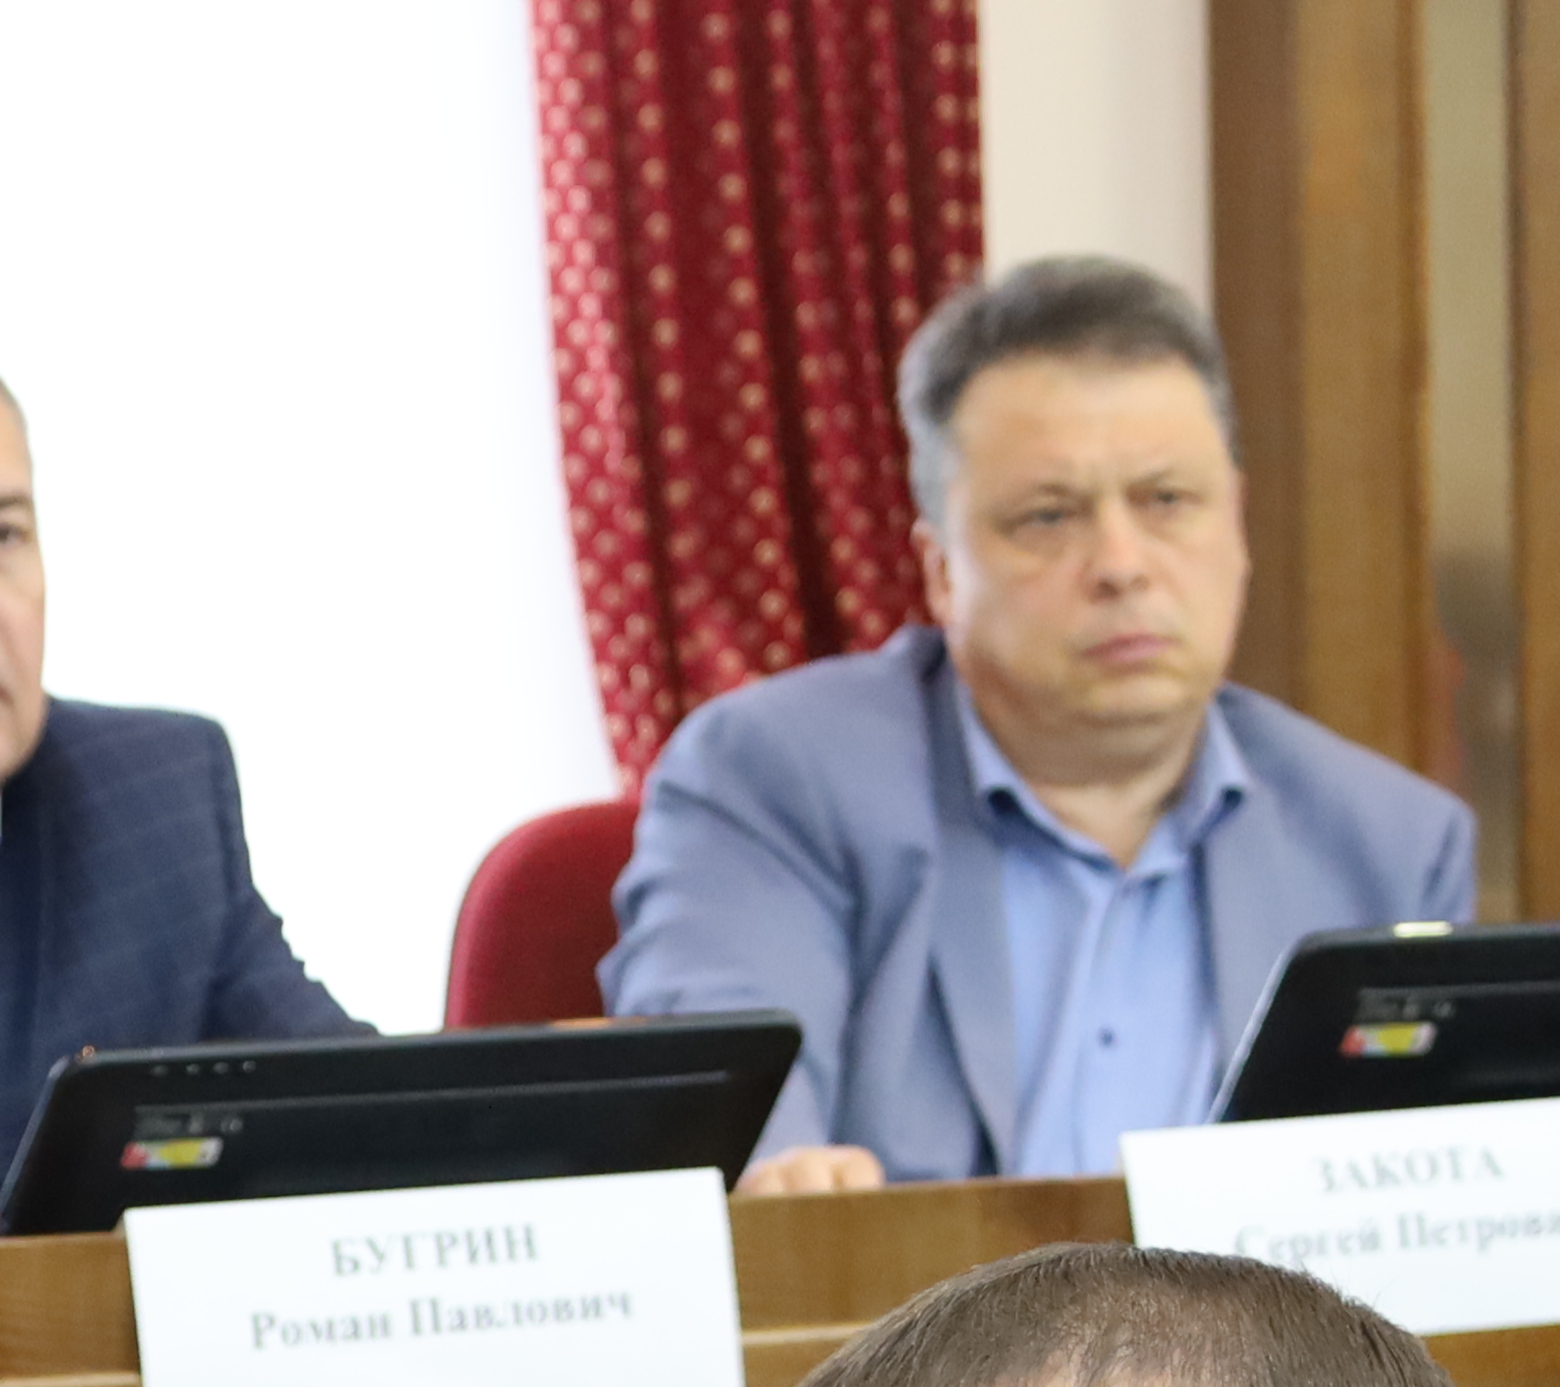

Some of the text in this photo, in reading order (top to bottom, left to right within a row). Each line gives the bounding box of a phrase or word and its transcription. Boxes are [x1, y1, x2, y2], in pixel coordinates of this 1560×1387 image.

[1316, 1144, 1507, 1195] ЗАКОТА
[330, 1222, 539, 1278] БУГРИН
[1234, 1212, 1381, 1266] Сергей
[249, 1289, 635, 1352] Роман Павлович
